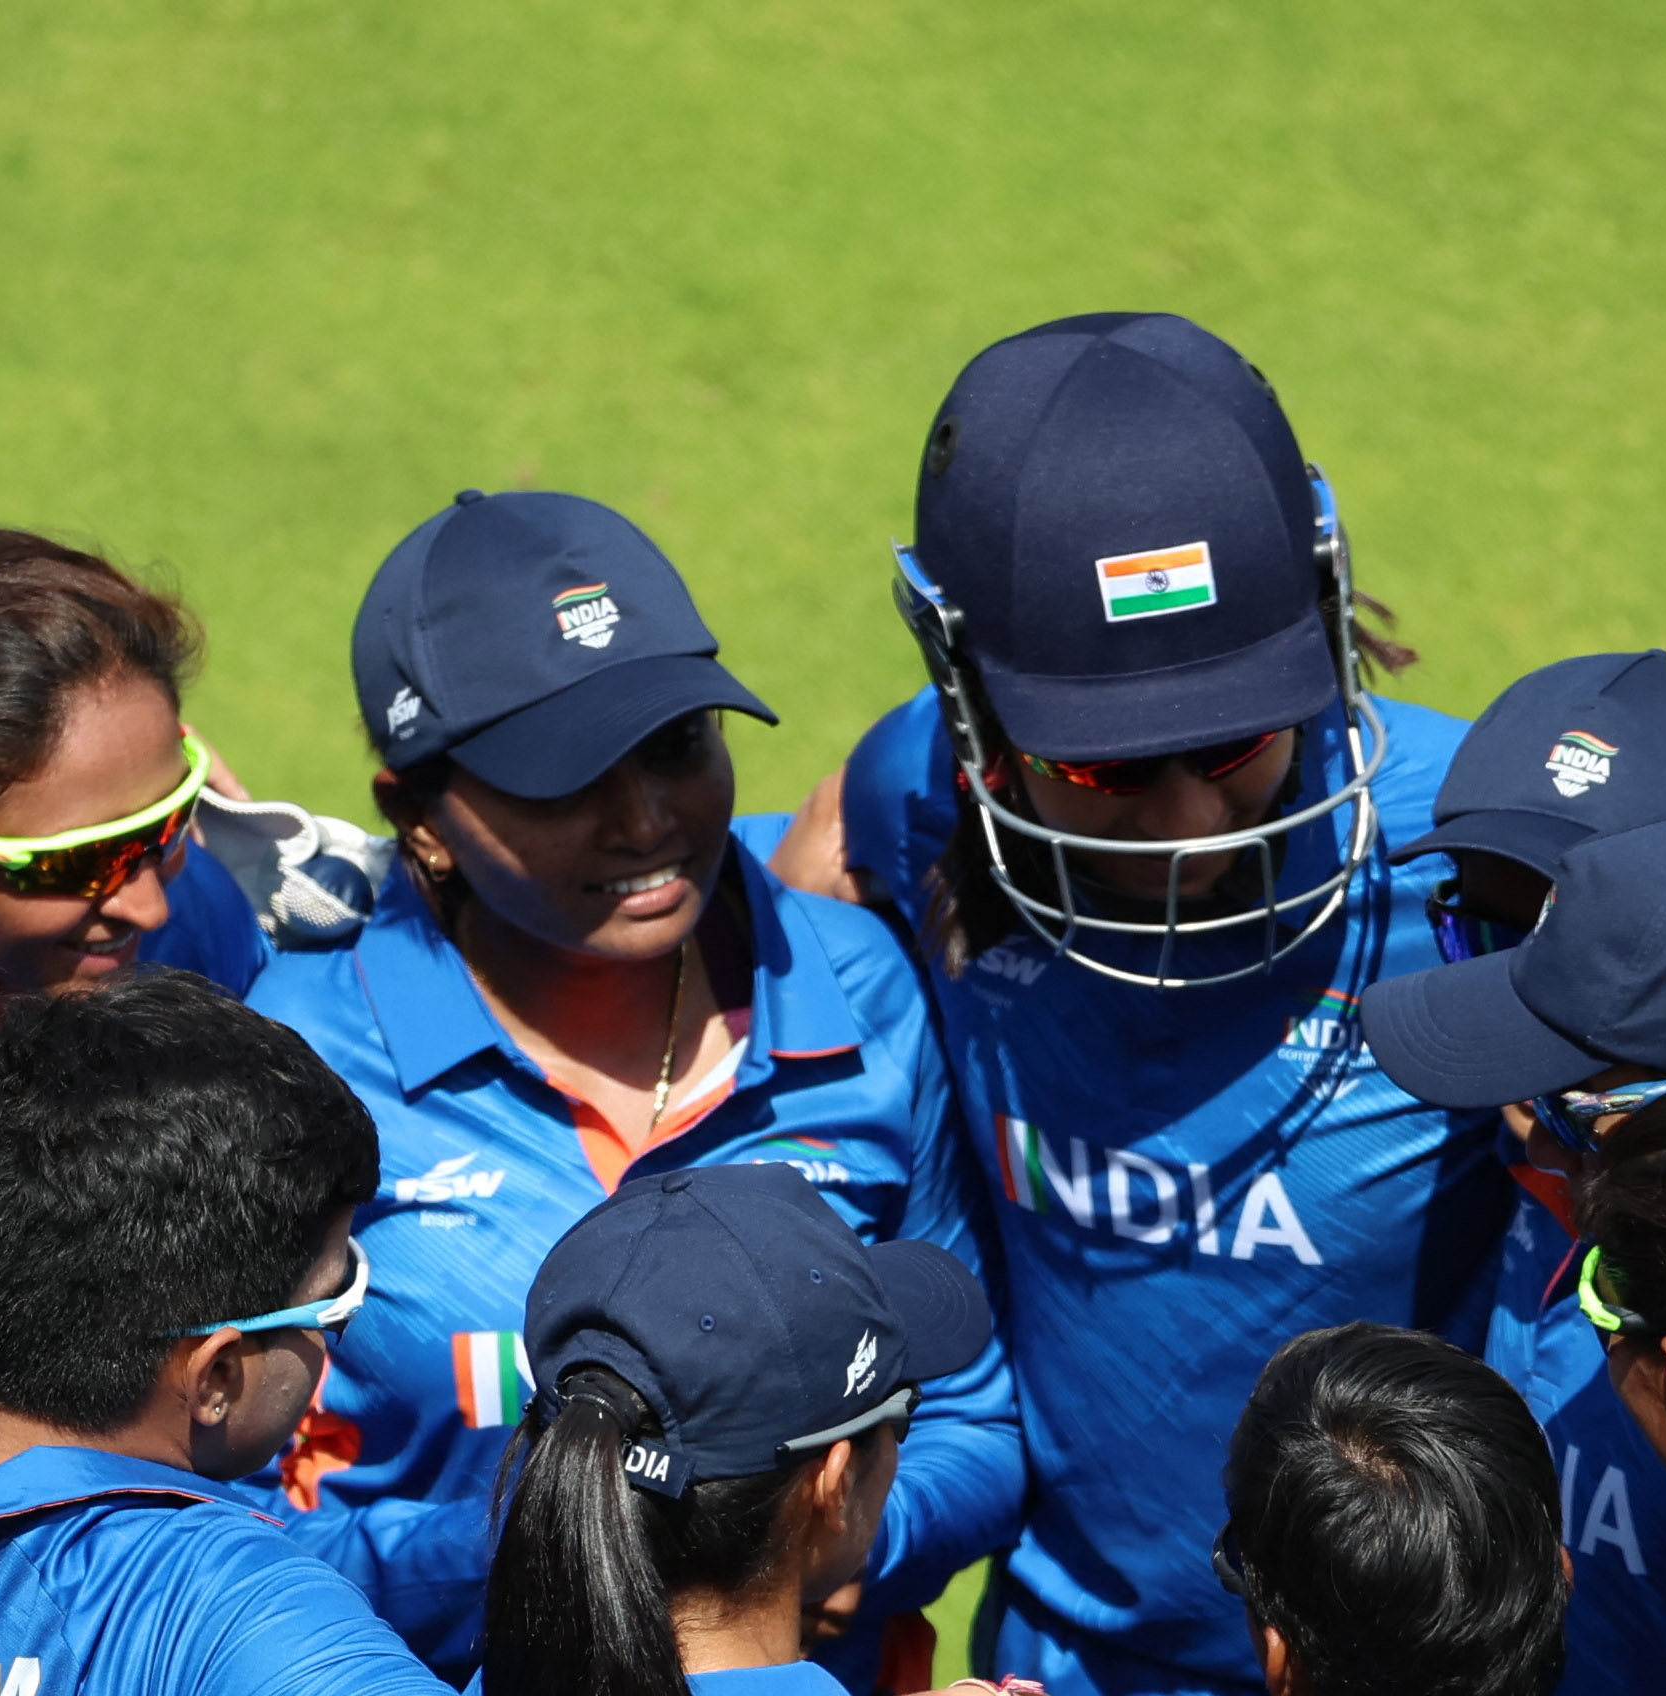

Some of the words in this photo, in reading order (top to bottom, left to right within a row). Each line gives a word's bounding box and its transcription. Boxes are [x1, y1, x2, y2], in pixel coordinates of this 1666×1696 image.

[556, 596, 619, 632] INDIA
[1548, 744, 1610, 778] INDIA
[1281, 1016, 1370, 1054] INDI
[993, 1112, 1324, 1266] INDIA
[624, 1444, 671, 1483] DIA
